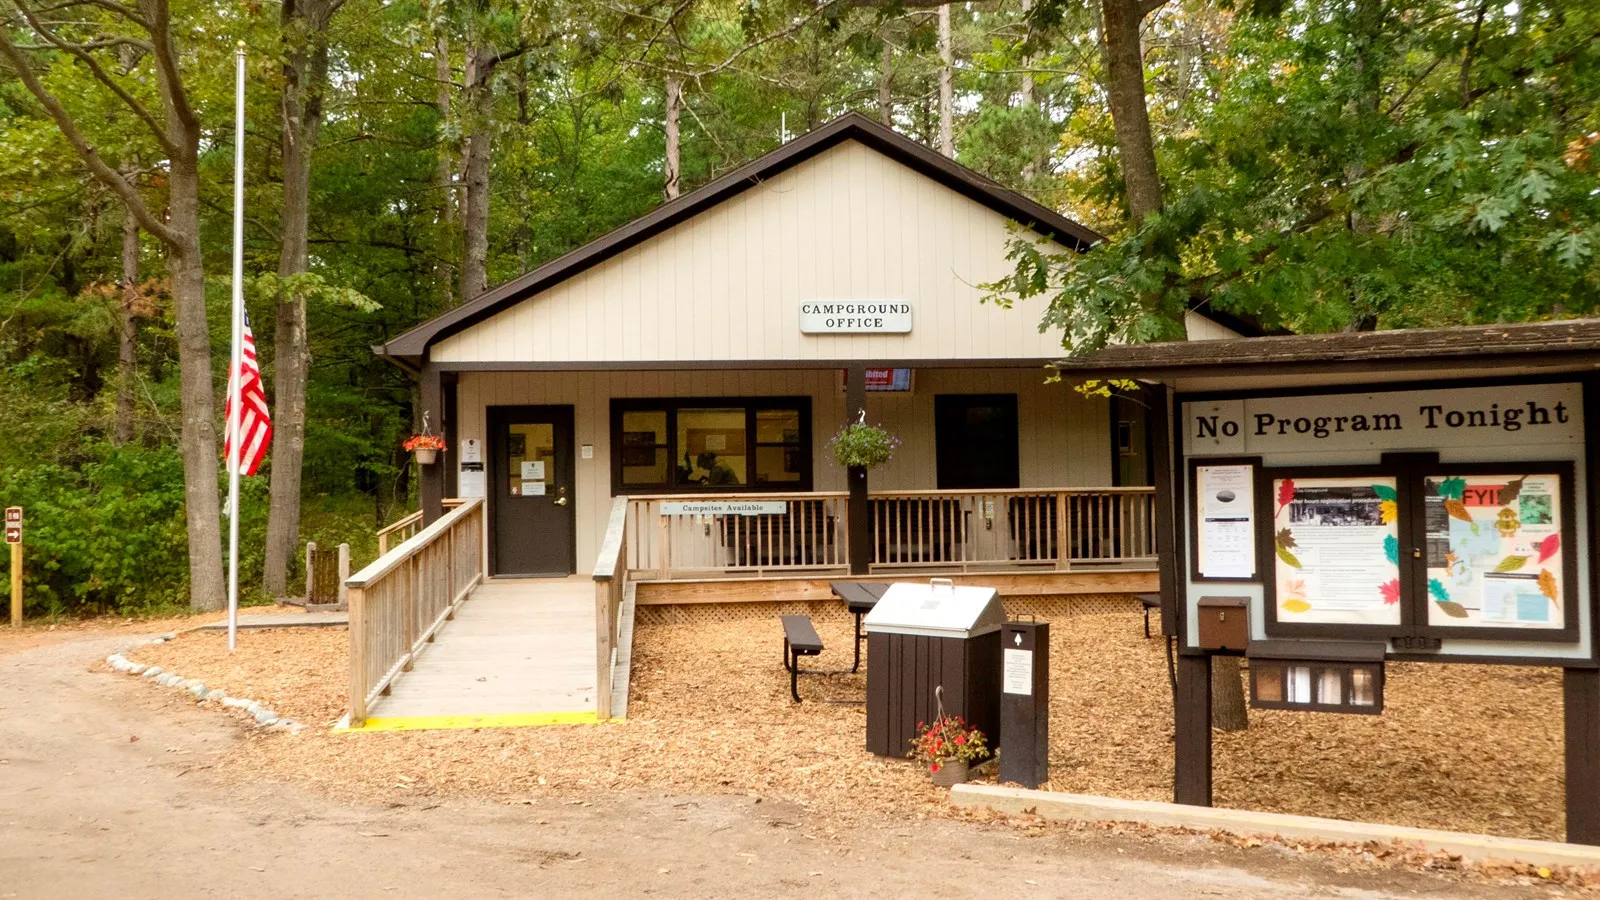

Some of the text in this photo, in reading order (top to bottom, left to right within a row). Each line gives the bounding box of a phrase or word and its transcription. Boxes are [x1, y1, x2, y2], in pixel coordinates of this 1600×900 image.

[802, 304, 910, 314] CAMPGROUND
[825, 318, 883, 328] OFFICE
[1196, 401, 1569, 439] No Program Tonight
[682, 504, 722, 512] Campsites
